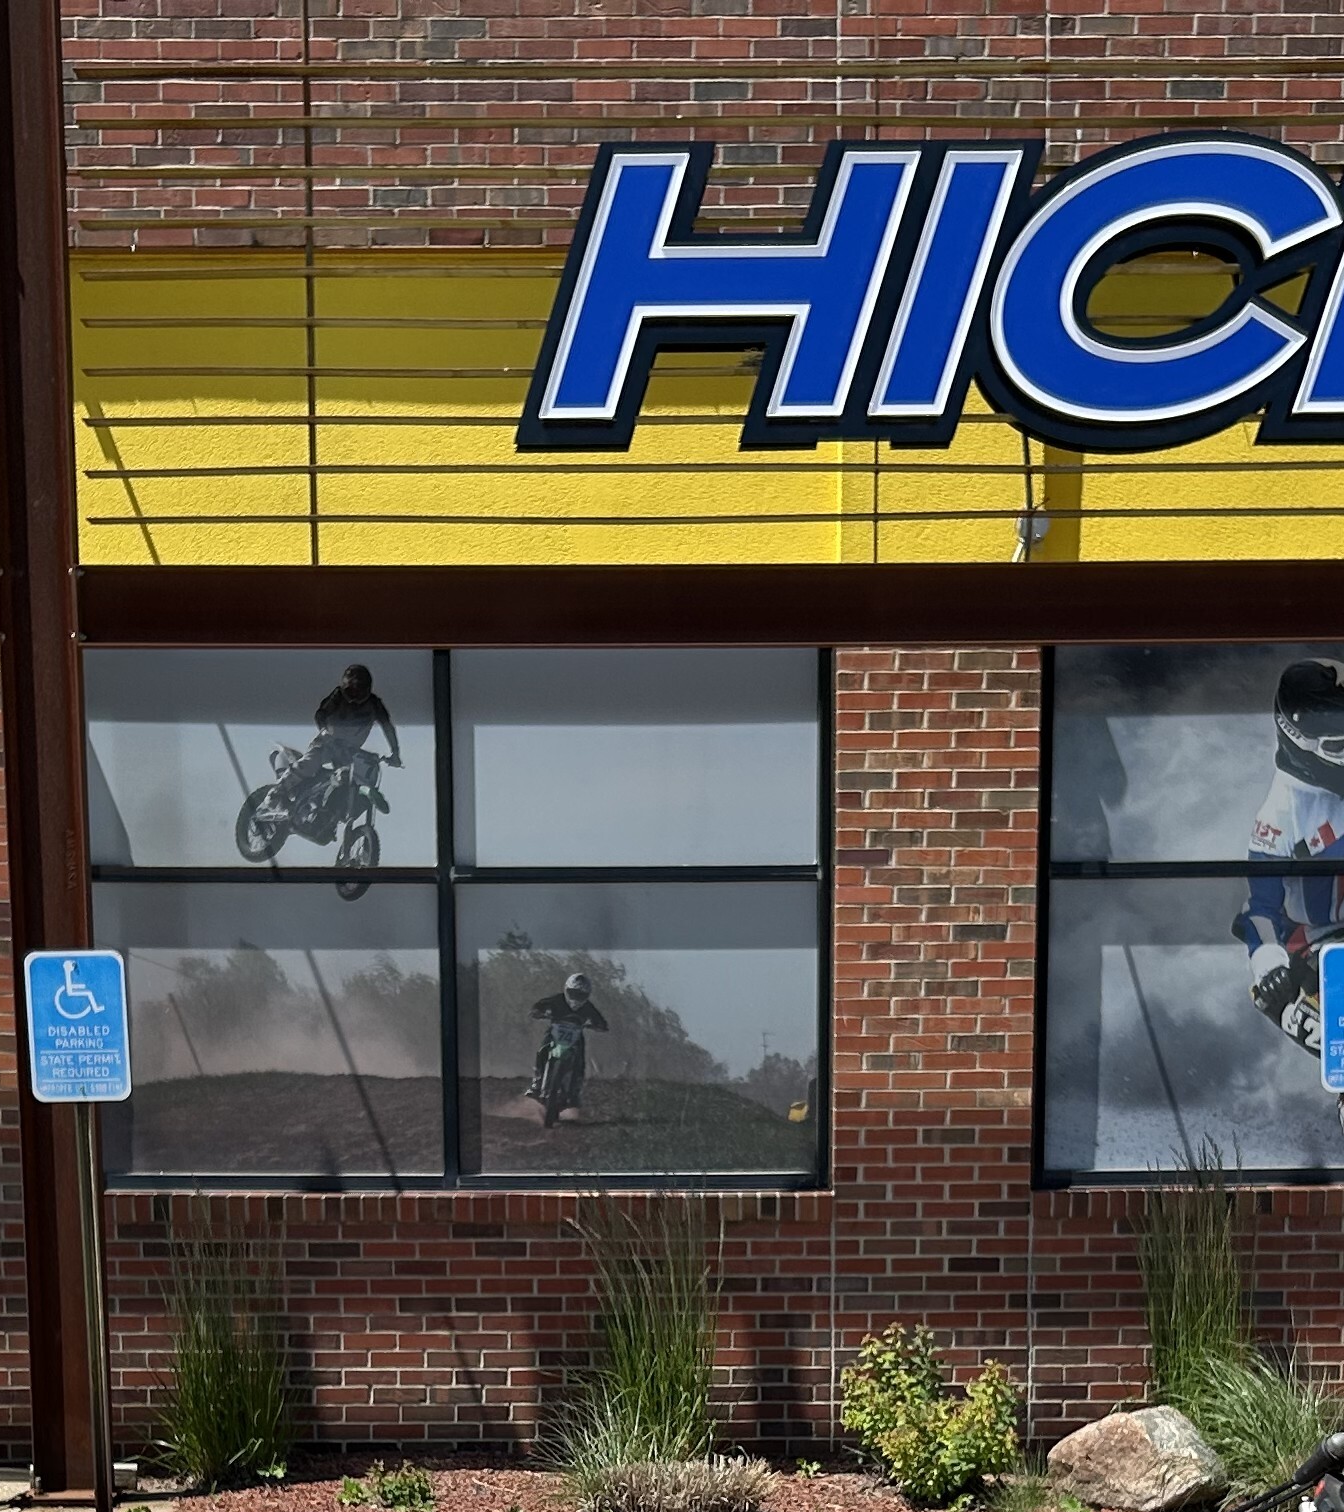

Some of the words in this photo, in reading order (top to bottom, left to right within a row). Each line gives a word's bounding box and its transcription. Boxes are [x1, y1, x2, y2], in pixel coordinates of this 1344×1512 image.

[47, 1026, 110, 1037] DISABLED
[54, 1039, 104, 1050] PARKING
[40, 1055, 74, 1066] STATE
[78, 1054, 121, 1065] PERMIT
[52, 1067, 110, 1077] REQUIRED
